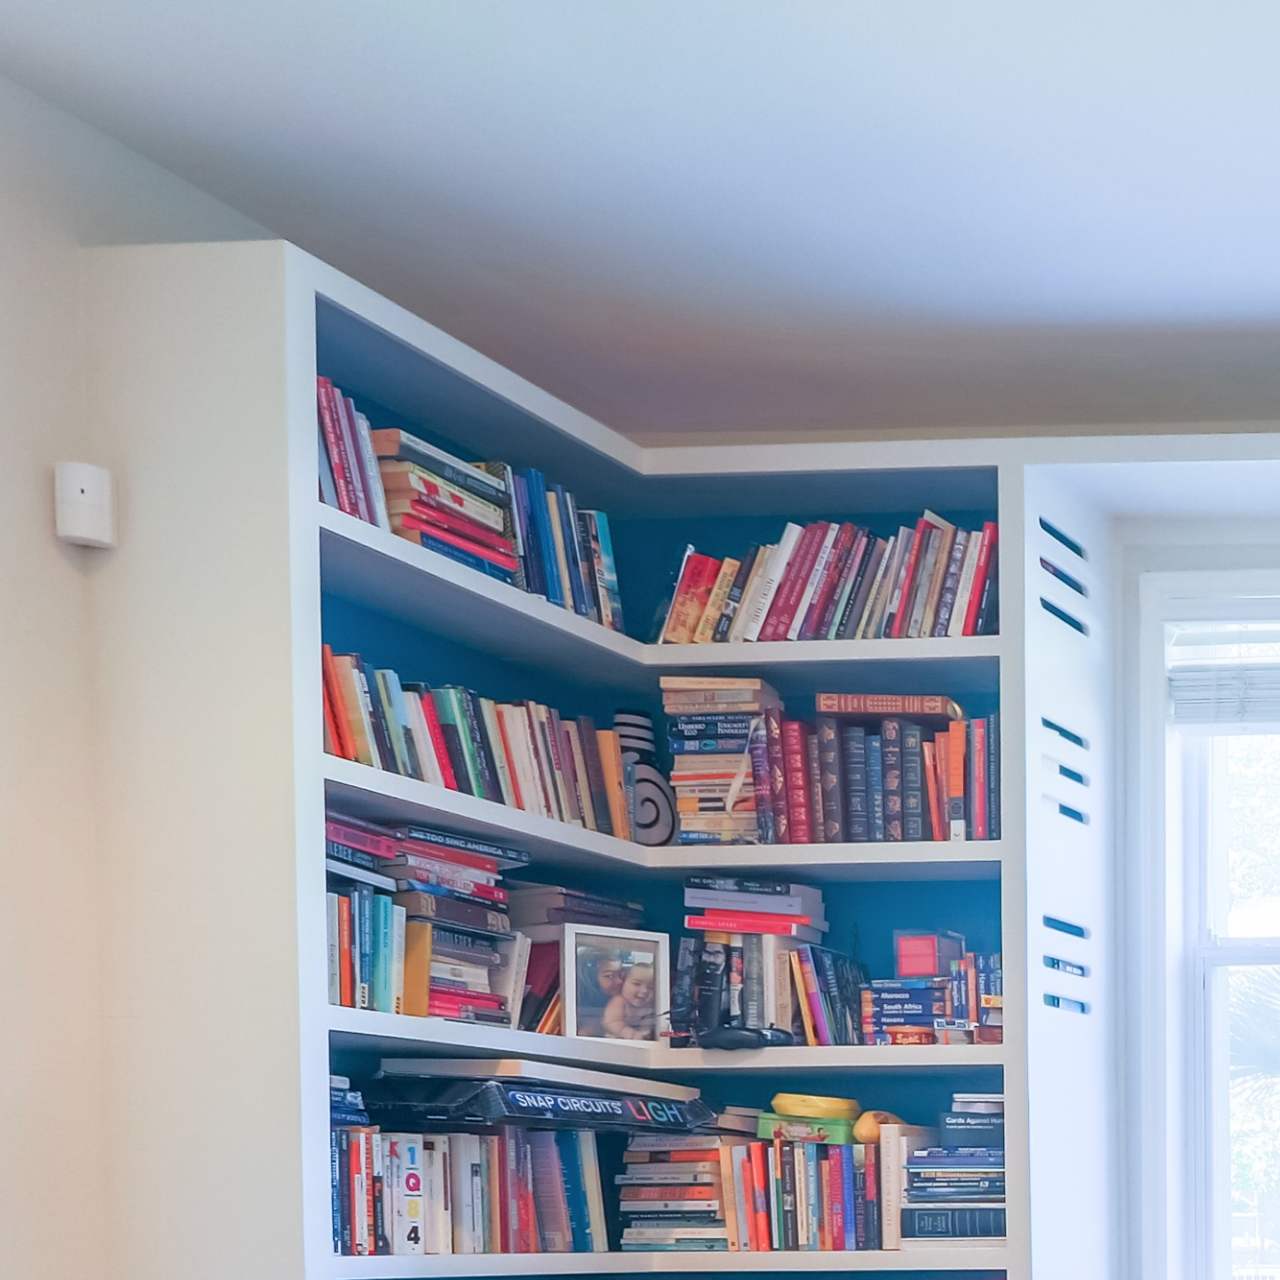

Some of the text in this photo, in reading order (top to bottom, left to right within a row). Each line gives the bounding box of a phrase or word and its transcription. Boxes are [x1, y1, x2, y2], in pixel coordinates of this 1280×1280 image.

[516, 1094, 689, 1123] SNAP CIRCUITS LIGH
